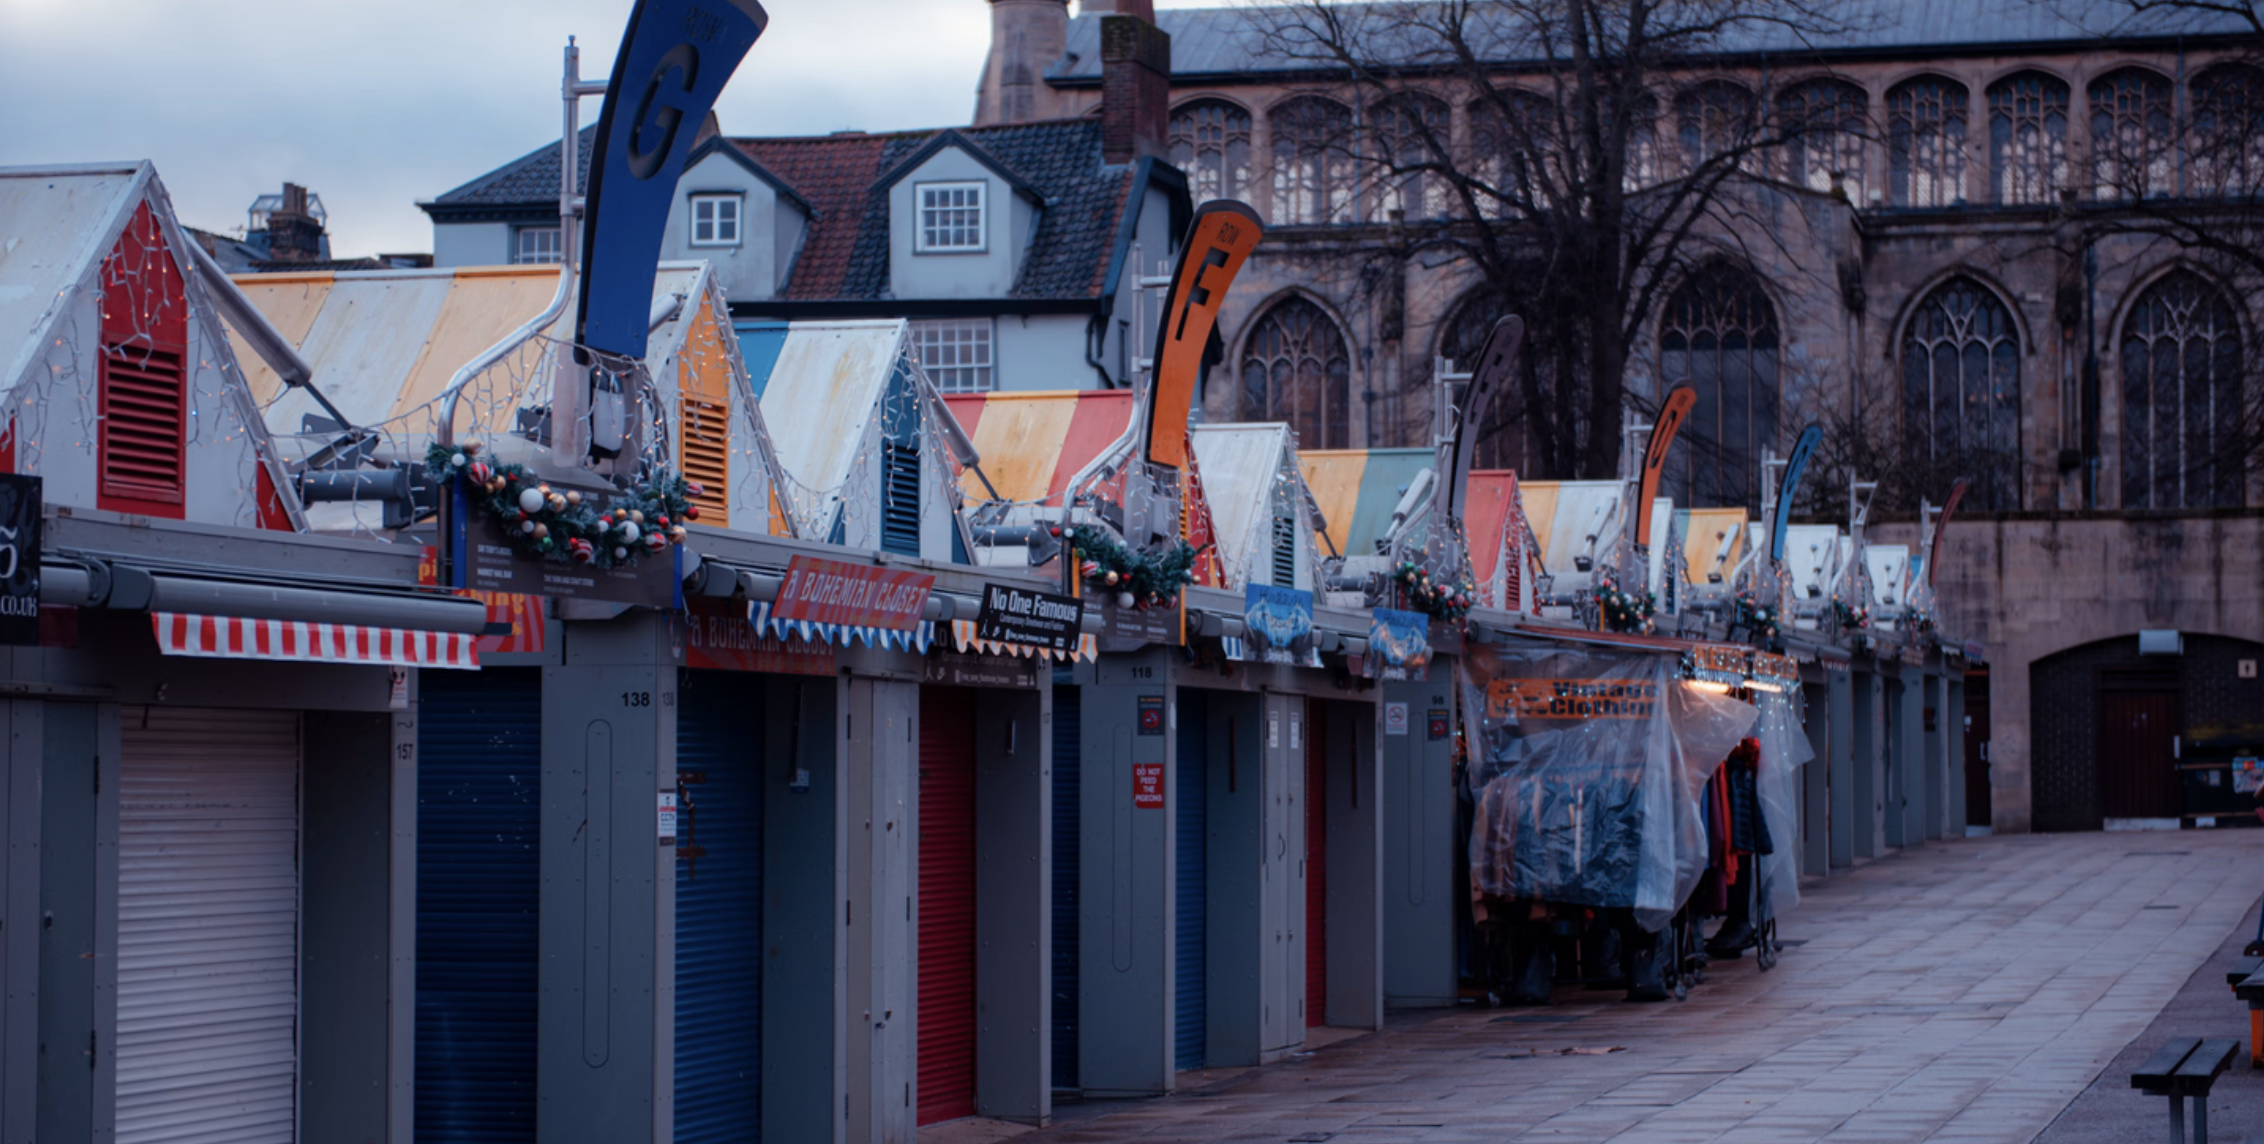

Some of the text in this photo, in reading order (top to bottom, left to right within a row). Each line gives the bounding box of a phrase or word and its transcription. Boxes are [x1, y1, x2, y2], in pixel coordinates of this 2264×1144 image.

[684, 6, 724, 42] ROW
[627, 43, 700, 181] G
[1216, 222, 1243, 246] ROW
[1175, 246, 1230, 341] F
[783, 570, 928, 615] A BOHEMIAN CLOSET
[990, 586, 1079, 625] No One Famous
[1132, 666, 1152, 678] 118
[622, 691, 651, 707] 138
[662, 692, 674, 706] 138
[397, 743, 414, 760] 157
[1136, 768, 1161, 776] DO NOT
[1140, 777, 1157, 785] FEED
[1142, 785, 1155, 793] THE
[1135, 794, 1163, 802] PIGEONS
